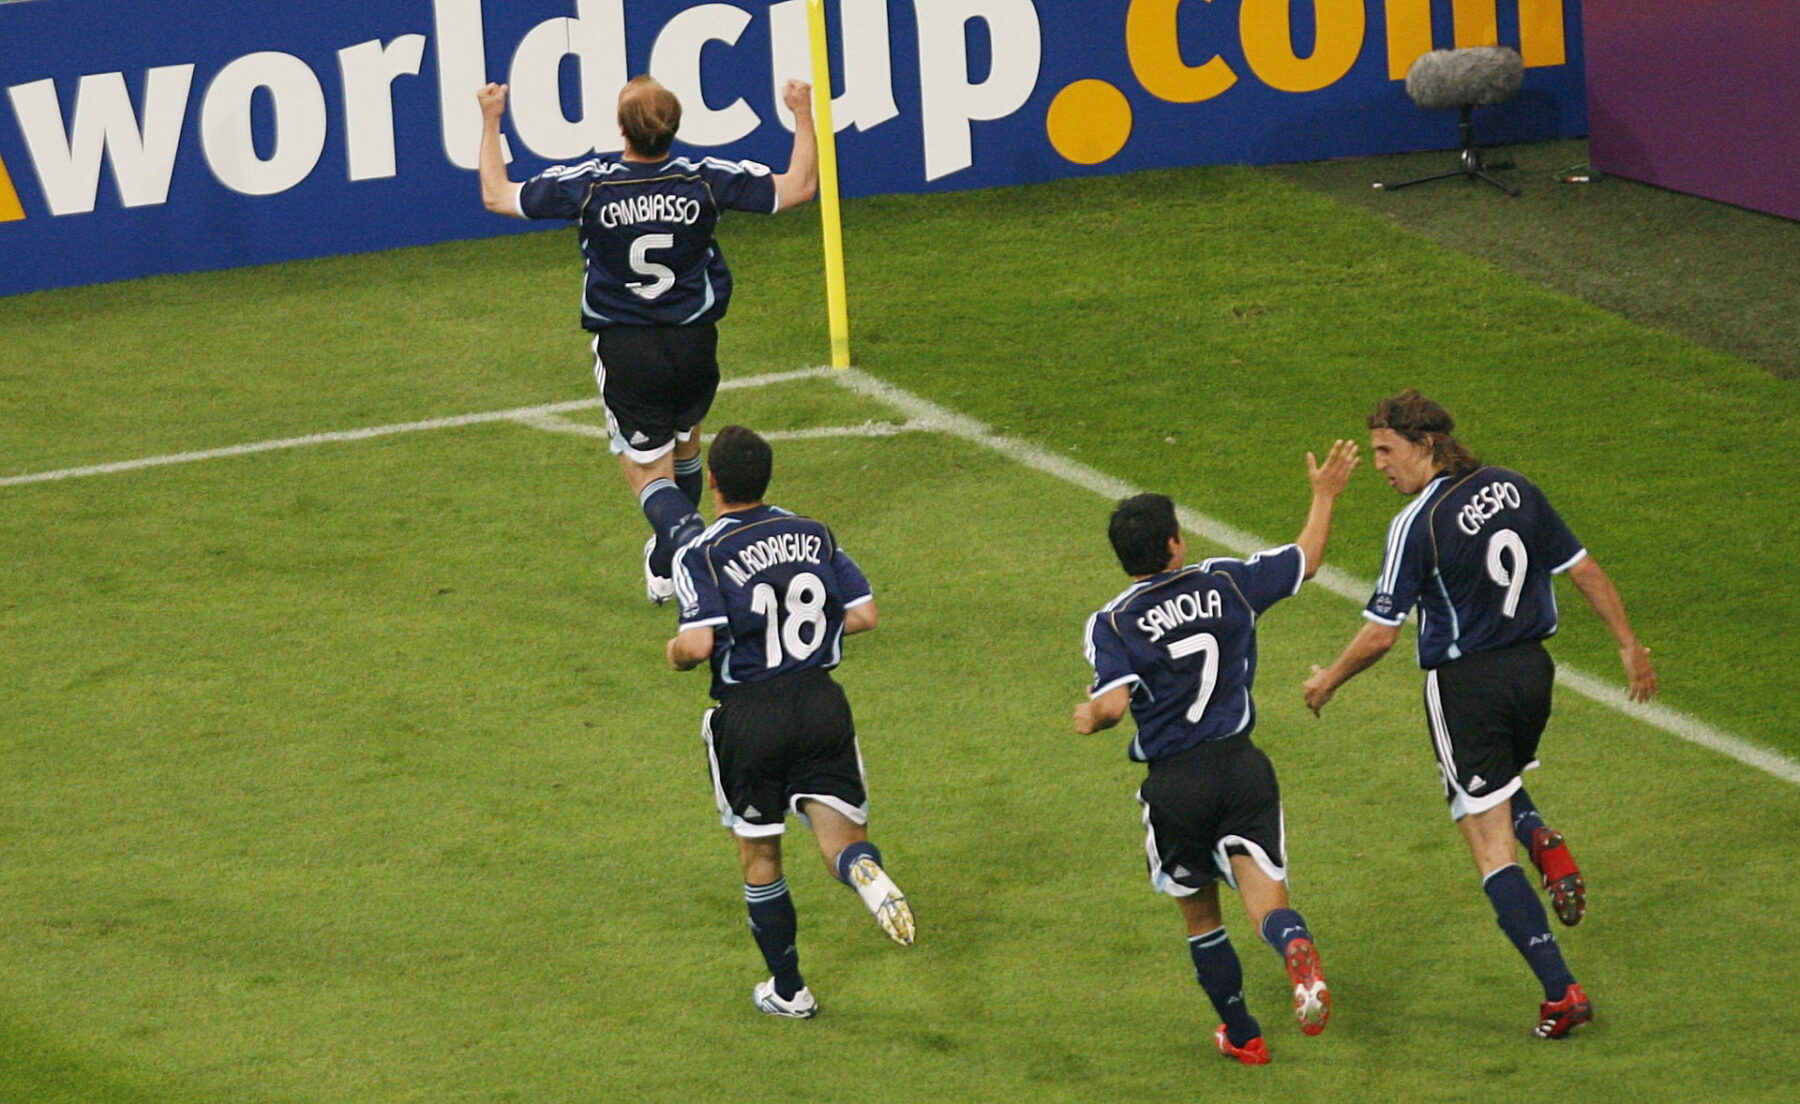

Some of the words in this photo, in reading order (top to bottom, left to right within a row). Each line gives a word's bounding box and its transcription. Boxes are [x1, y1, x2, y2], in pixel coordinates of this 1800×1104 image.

[0, 0, 1566, 222] worldcup.com
[601, 194, 700, 228] CAMBIASSO
[625, 233, 676, 300] 5
[1457, 481, 1521, 535] CRESPO
[723, 533, 821, 587] M.RODRIGUEZ
[1486, 528, 1528, 619] 9
[751, 572, 827, 669] 18
[1136, 589, 1222, 643] SAVIOLA
[1167, 632, 1219, 723] 7
